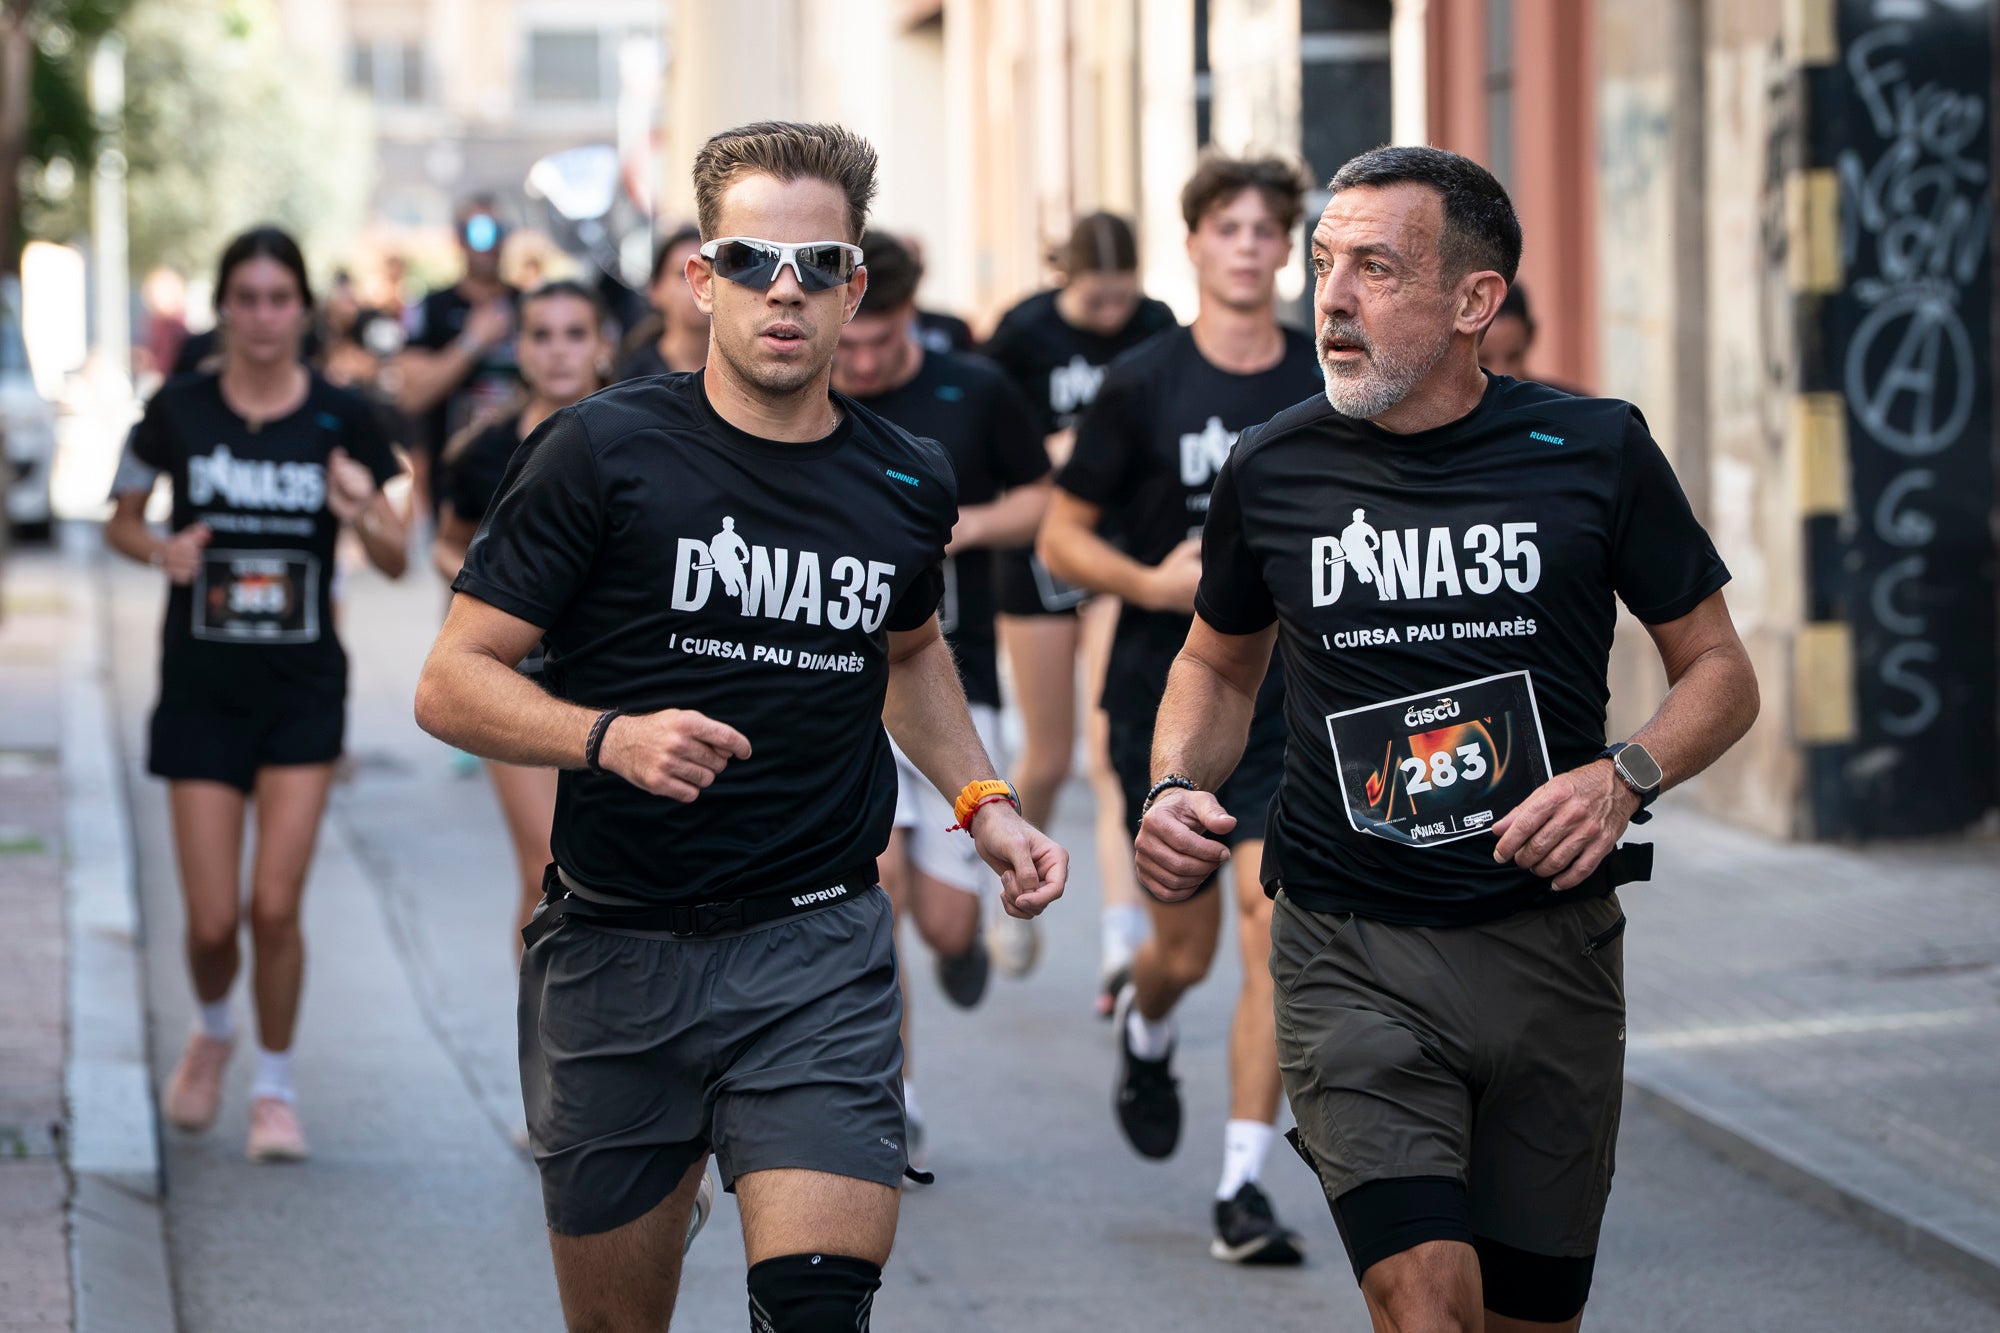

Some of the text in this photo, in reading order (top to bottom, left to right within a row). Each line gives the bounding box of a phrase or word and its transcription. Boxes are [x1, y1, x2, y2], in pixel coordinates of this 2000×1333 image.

[1529, 431, 1565, 446] RUNNEK
[885, 469, 920, 487] RUNNEK
[1322, 615, 1537, 650] I CURSA PAU DINARÈS
[668, 633, 865, 673] I CURSA PAU DINARÈS
[1399, 742, 1487, 796] 283
[791, 884, 848, 907] KIPRUN
